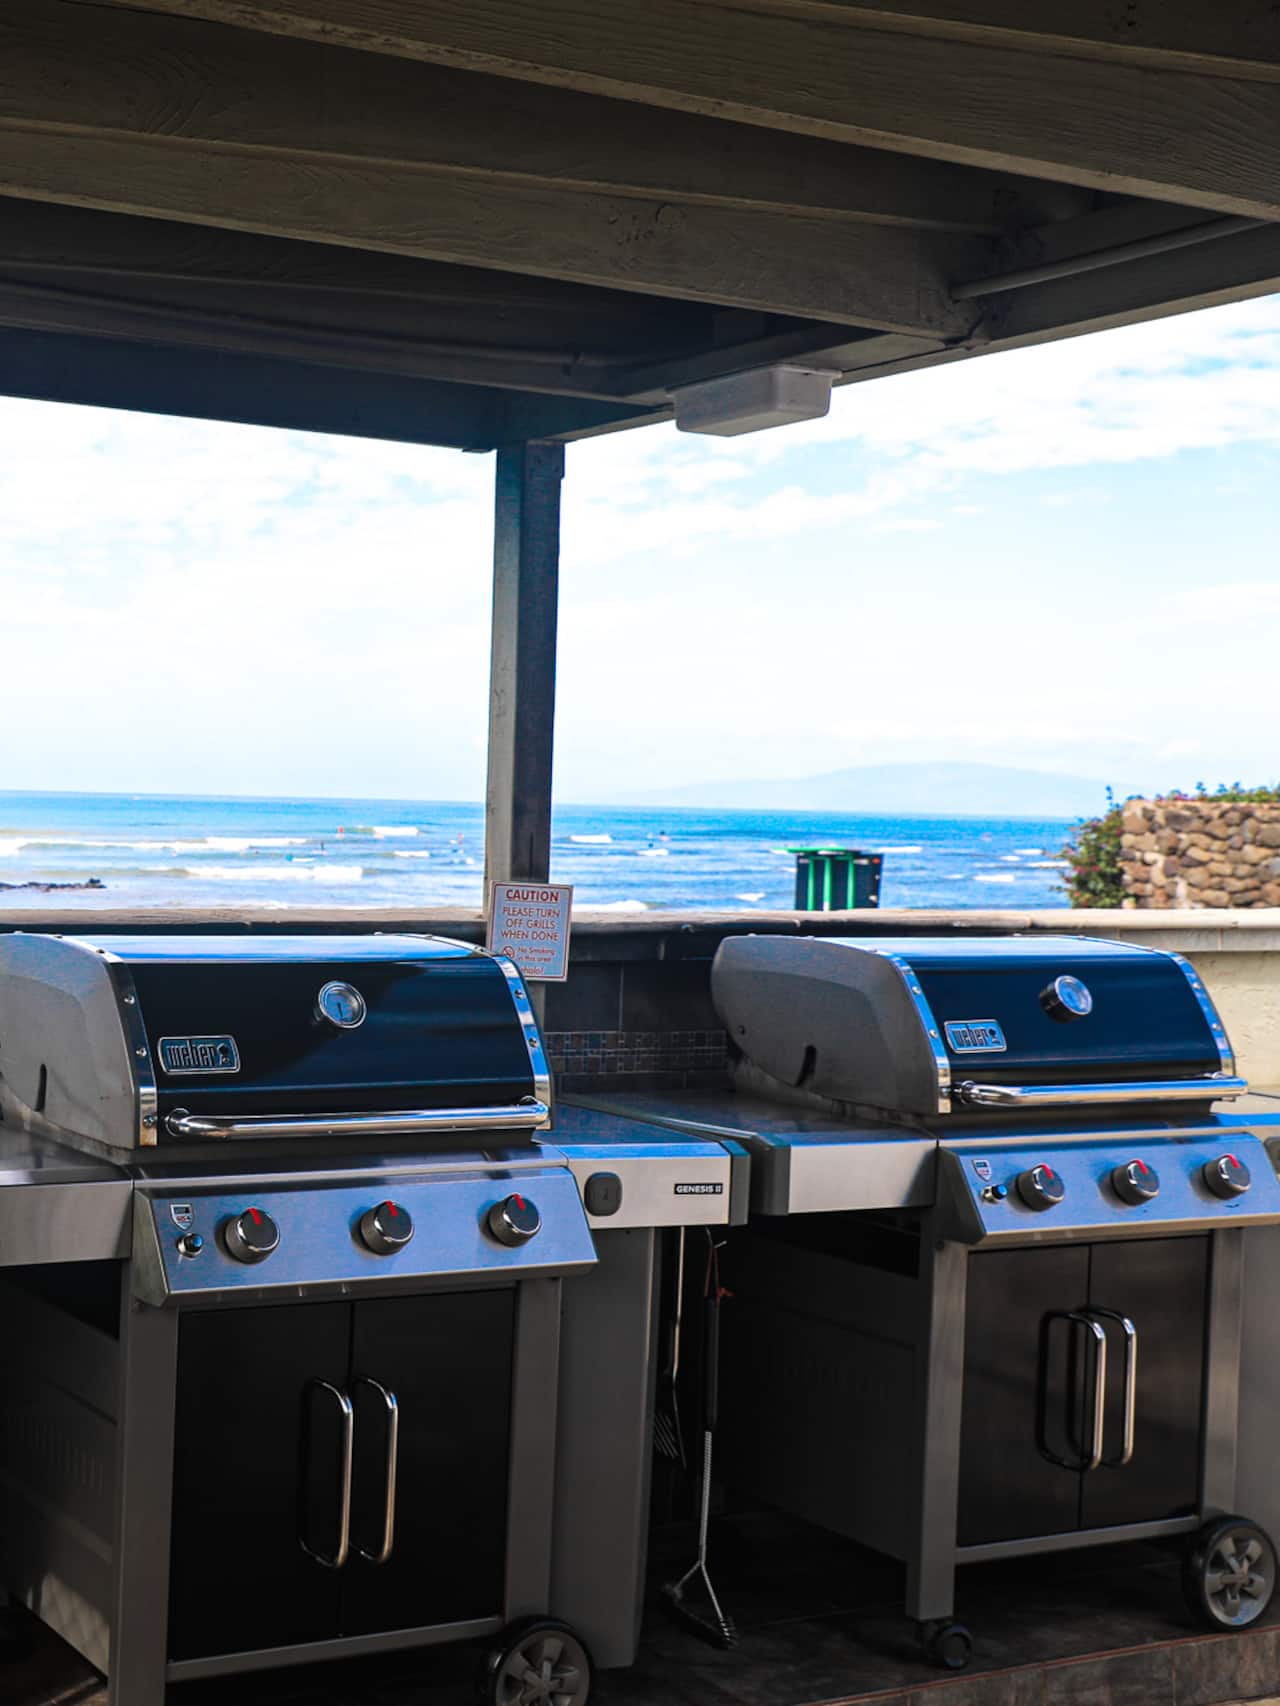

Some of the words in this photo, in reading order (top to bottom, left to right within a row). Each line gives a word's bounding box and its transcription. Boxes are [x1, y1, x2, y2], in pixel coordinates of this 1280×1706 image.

[506, 889, 559, 902] CAUTION
[502, 906, 534, 917] PLEASE
[536, 908, 560, 918] TURN
[505, 919, 522, 928] OFF
[526, 919, 556, 930] GRILLS
[501, 929, 529, 940] WHEN
[531, 931, 559, 941] DONE
[676, 1185, 714, 1194] GENESIS
